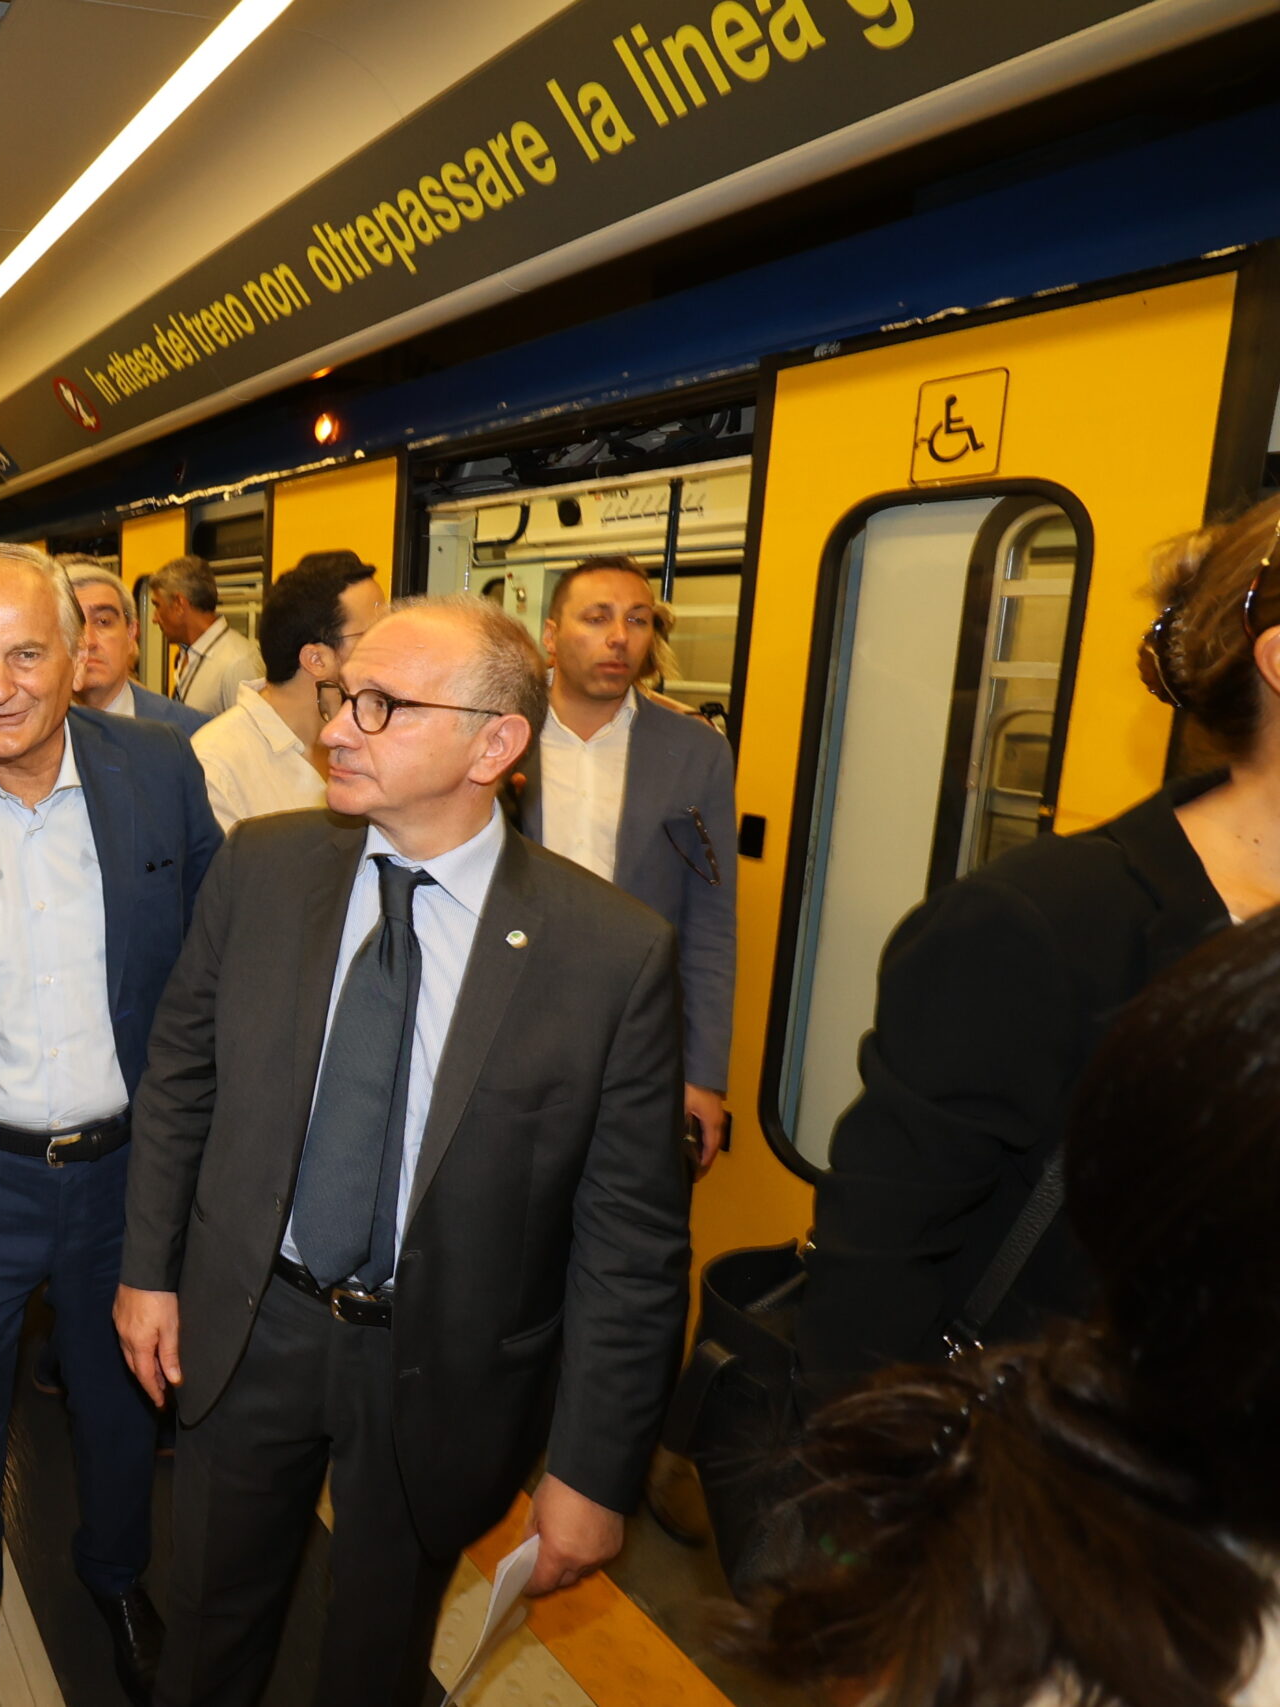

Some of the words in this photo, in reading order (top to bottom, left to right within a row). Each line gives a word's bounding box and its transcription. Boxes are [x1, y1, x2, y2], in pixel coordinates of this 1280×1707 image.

[84, 367, 121, 405] In
[107, 351, 168, 396] attesa
[153, 315, 201, 371] del
[179, 293, 255, 357] treno
[243, 263, 312, 324] non
[306, 120, 558, 293] oltrepassare
[546, 78, 636, 164] la
[612, 0, 826, 127] linea
